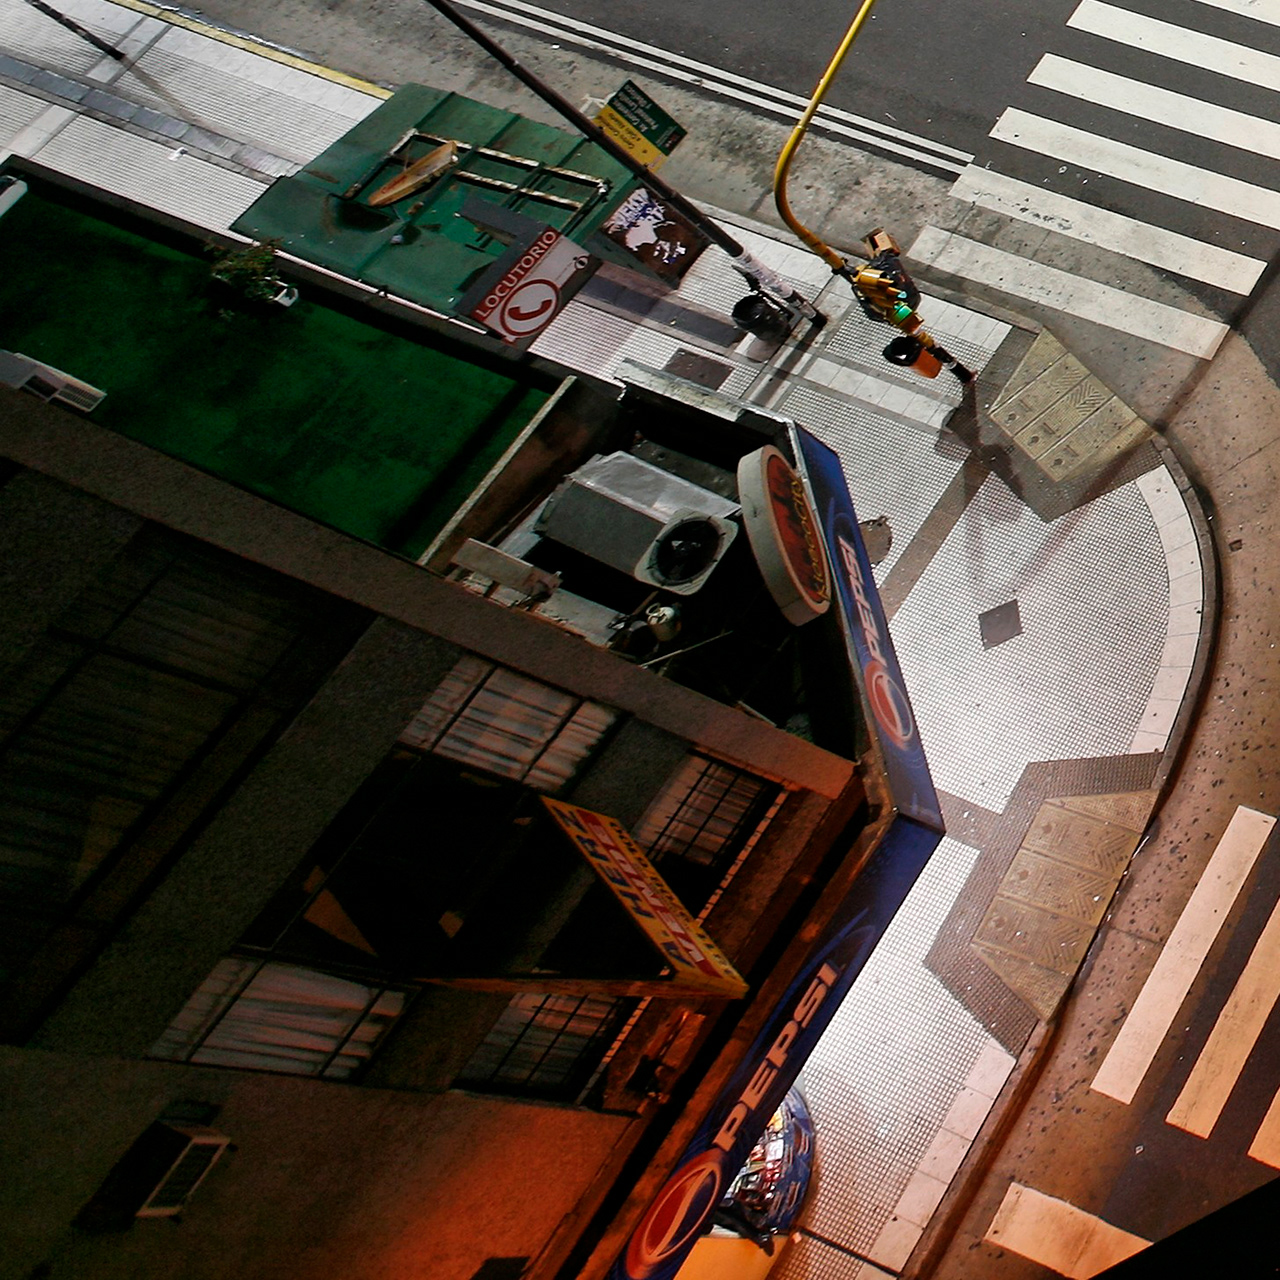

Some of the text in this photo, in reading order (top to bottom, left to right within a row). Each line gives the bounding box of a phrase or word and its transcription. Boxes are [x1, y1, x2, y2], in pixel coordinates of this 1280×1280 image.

[475, 230, 557, 318] LOCUTORIO
[837, 535, 888, 668] PEPSI
[588, 822, 706, 962] VENDE
[711, 958, 840, 1152] PEPSI
